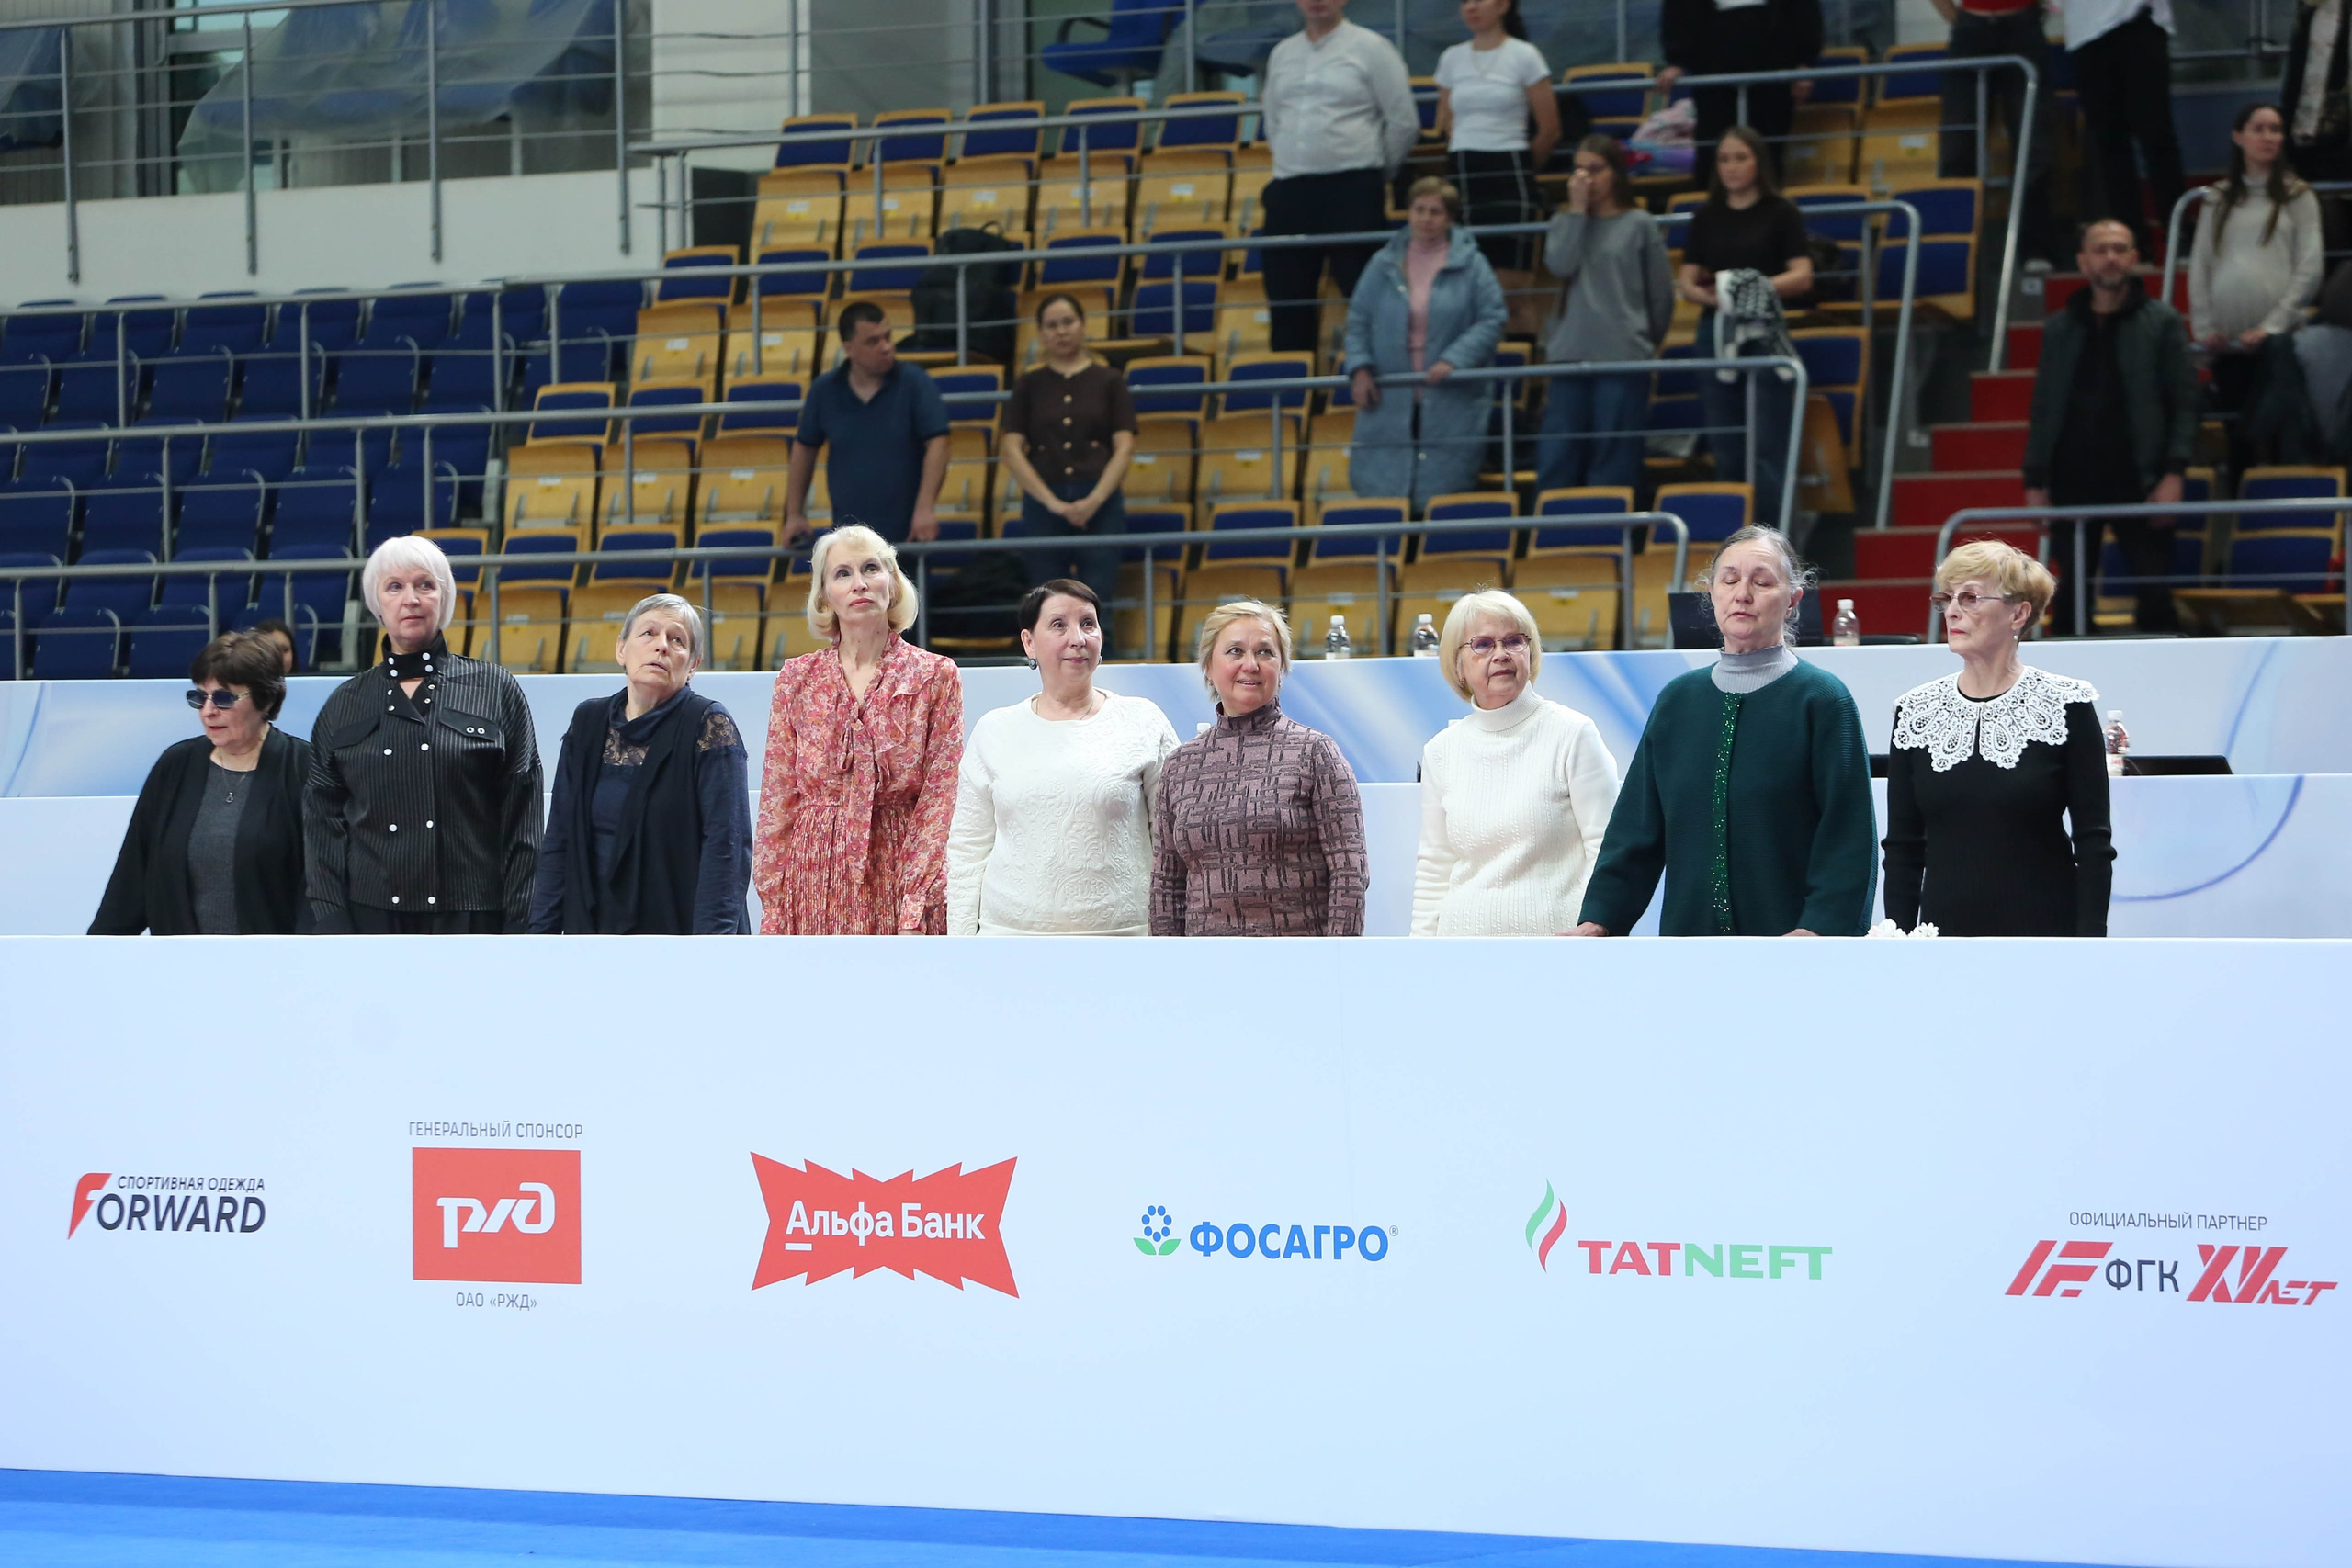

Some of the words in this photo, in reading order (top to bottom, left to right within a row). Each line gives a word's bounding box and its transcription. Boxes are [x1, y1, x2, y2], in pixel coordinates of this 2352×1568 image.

[409, 1120, 511, 1138] ГЕНЕРАЛЬНЫЙ
[515, 1122, 583, 1139] СПОНСОР
[118, 1175, 204, 1190] СПОРТИВНАЯ
[208, 1177, 266, 1193] ОДЕЖДА
[68, 1172, 266, 1240] FORWARD
[785, 1200, 895, 1247] Альфа
[900, 1202, 986, 1240] Банк
[2069, 1211, 2193, 1230] ОФИЦИАЛЬНЫЙ
[2197, 1214, 2267, 1231] ПАРТНЕР
[1577, 1240, 1833, 1280] TATNEFT
[2105, 1258, 2180, 1292] ФГК
[456, 1292, 484, 1308] ОАО
[490, 1293, 537, 1312] «РЖД»
